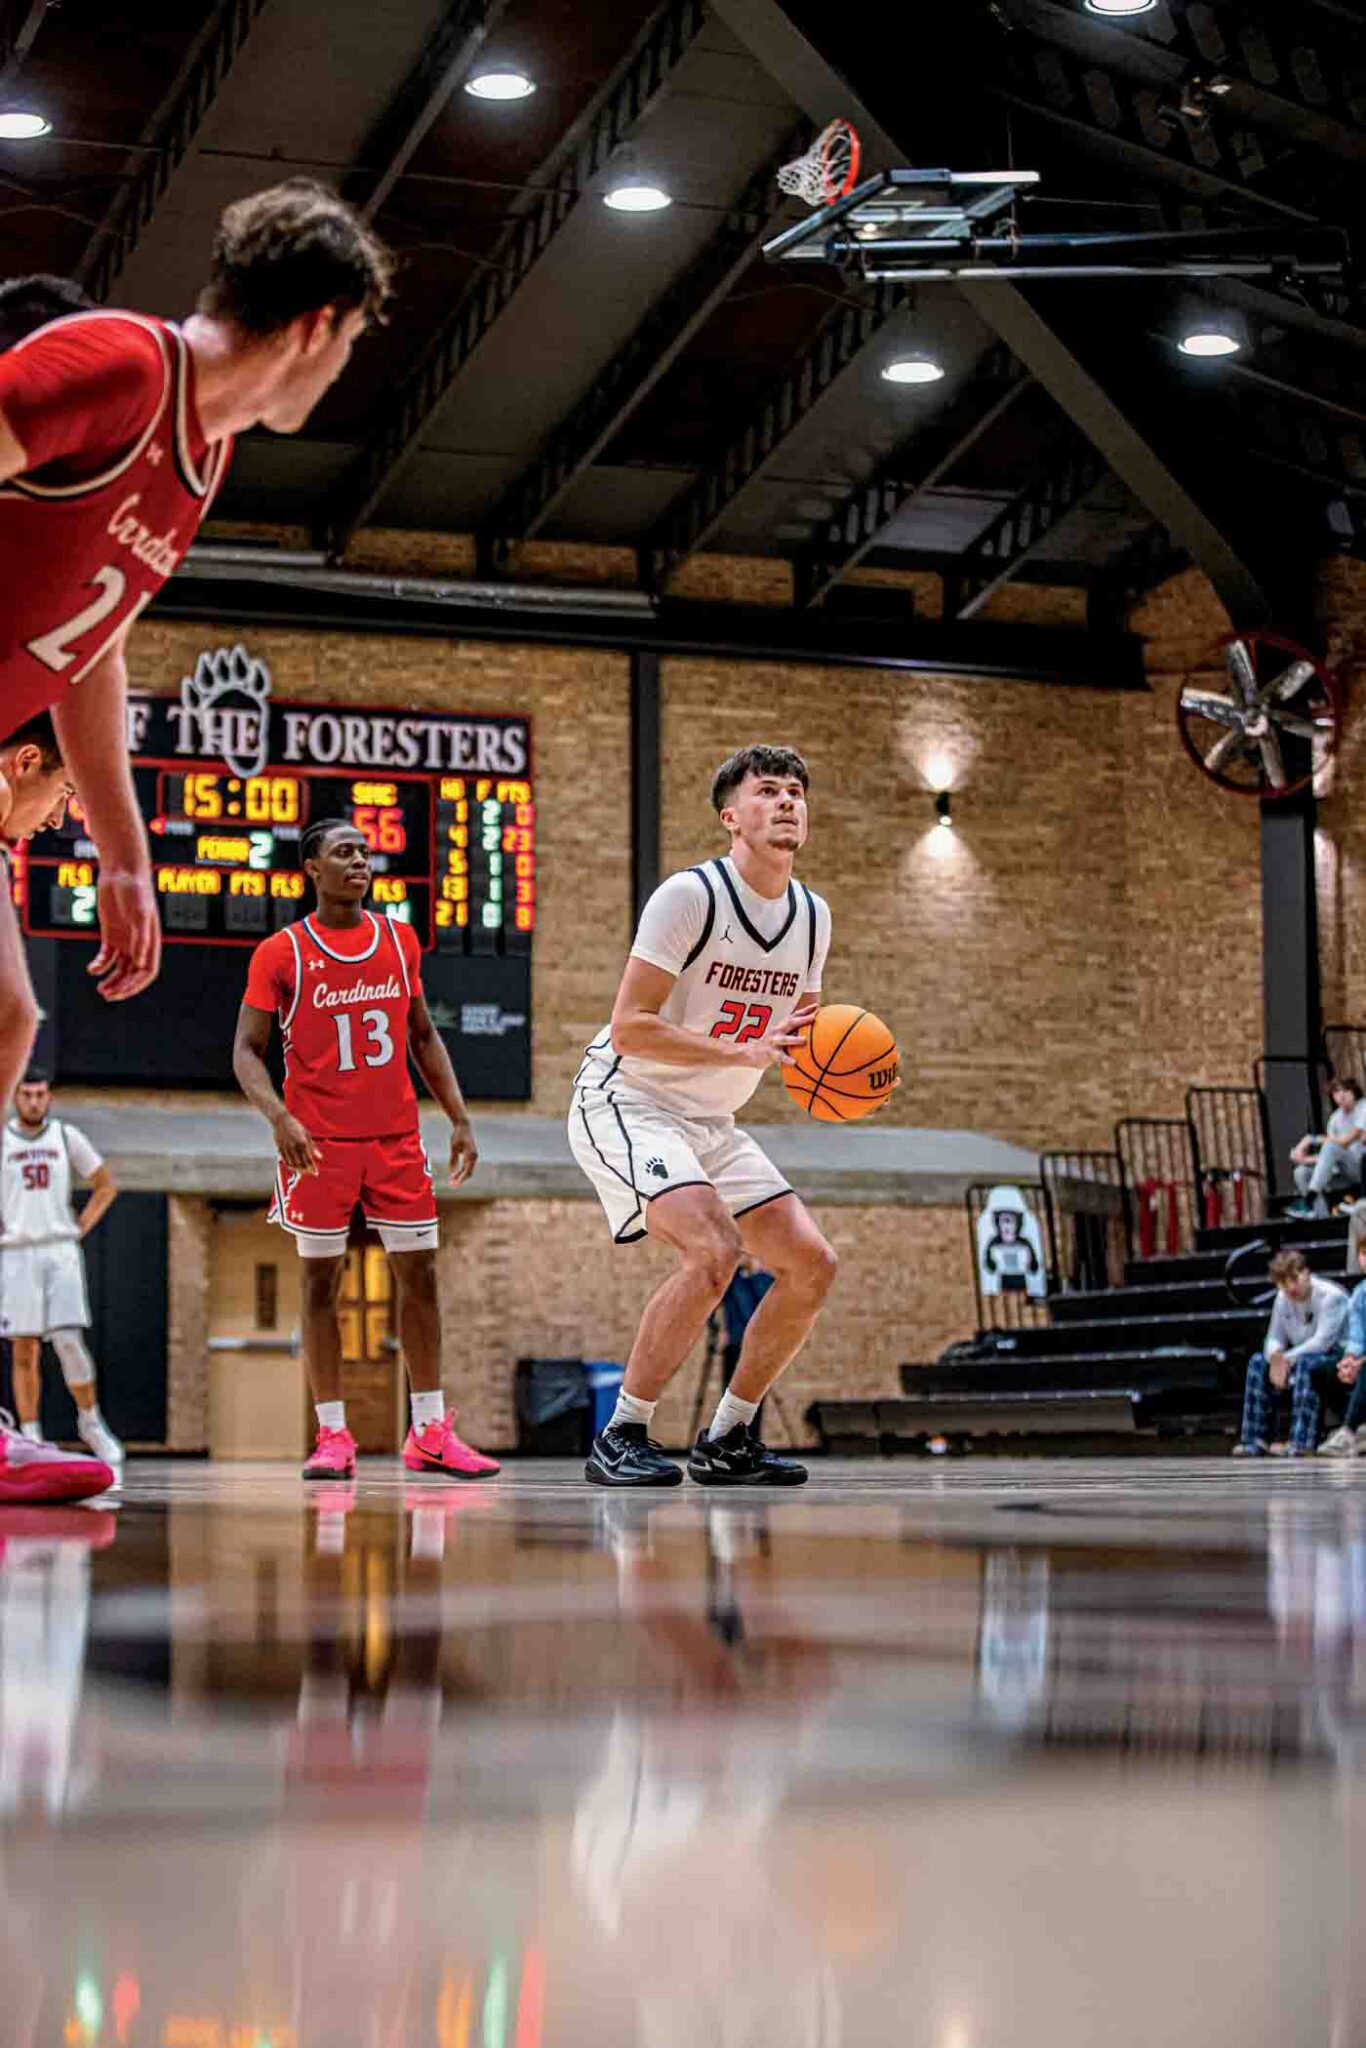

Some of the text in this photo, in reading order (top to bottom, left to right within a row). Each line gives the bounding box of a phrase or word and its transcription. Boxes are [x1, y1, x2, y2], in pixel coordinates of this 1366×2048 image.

[167, 706, 261, 757] THE
[283, 713, 526, 774] FORESTERS
[183, 774, 299, 822] 15:00
[482, 799, 501, 825] 2
[353, 806, 407, 853] 56
[449, 824, 468, 849] 4
[482, 825, 501, 851] 2
[249, 832, 273, 869] 2
[448, 849, 468, 875] 5
[489, 852, 502, 876] 1
[229, 872, 266, 897] PTS
[270, 873, 305, 899] FLS
[372, 877, 406, 902] FLS
[442, 874, 468, 900] 13
[489, 877, 502, 902] 1
[71, 886, 96, 923] 2
[435, 899, 468, 927] 21
[312, 974, 400, 1009] Cardinals
[704, 960, 799, 998] FORESTERS
[709, 999, 773, 1043] 22
[332, 1009, 394, 1072] 13
[22, 1163, 49, 1190] 50
